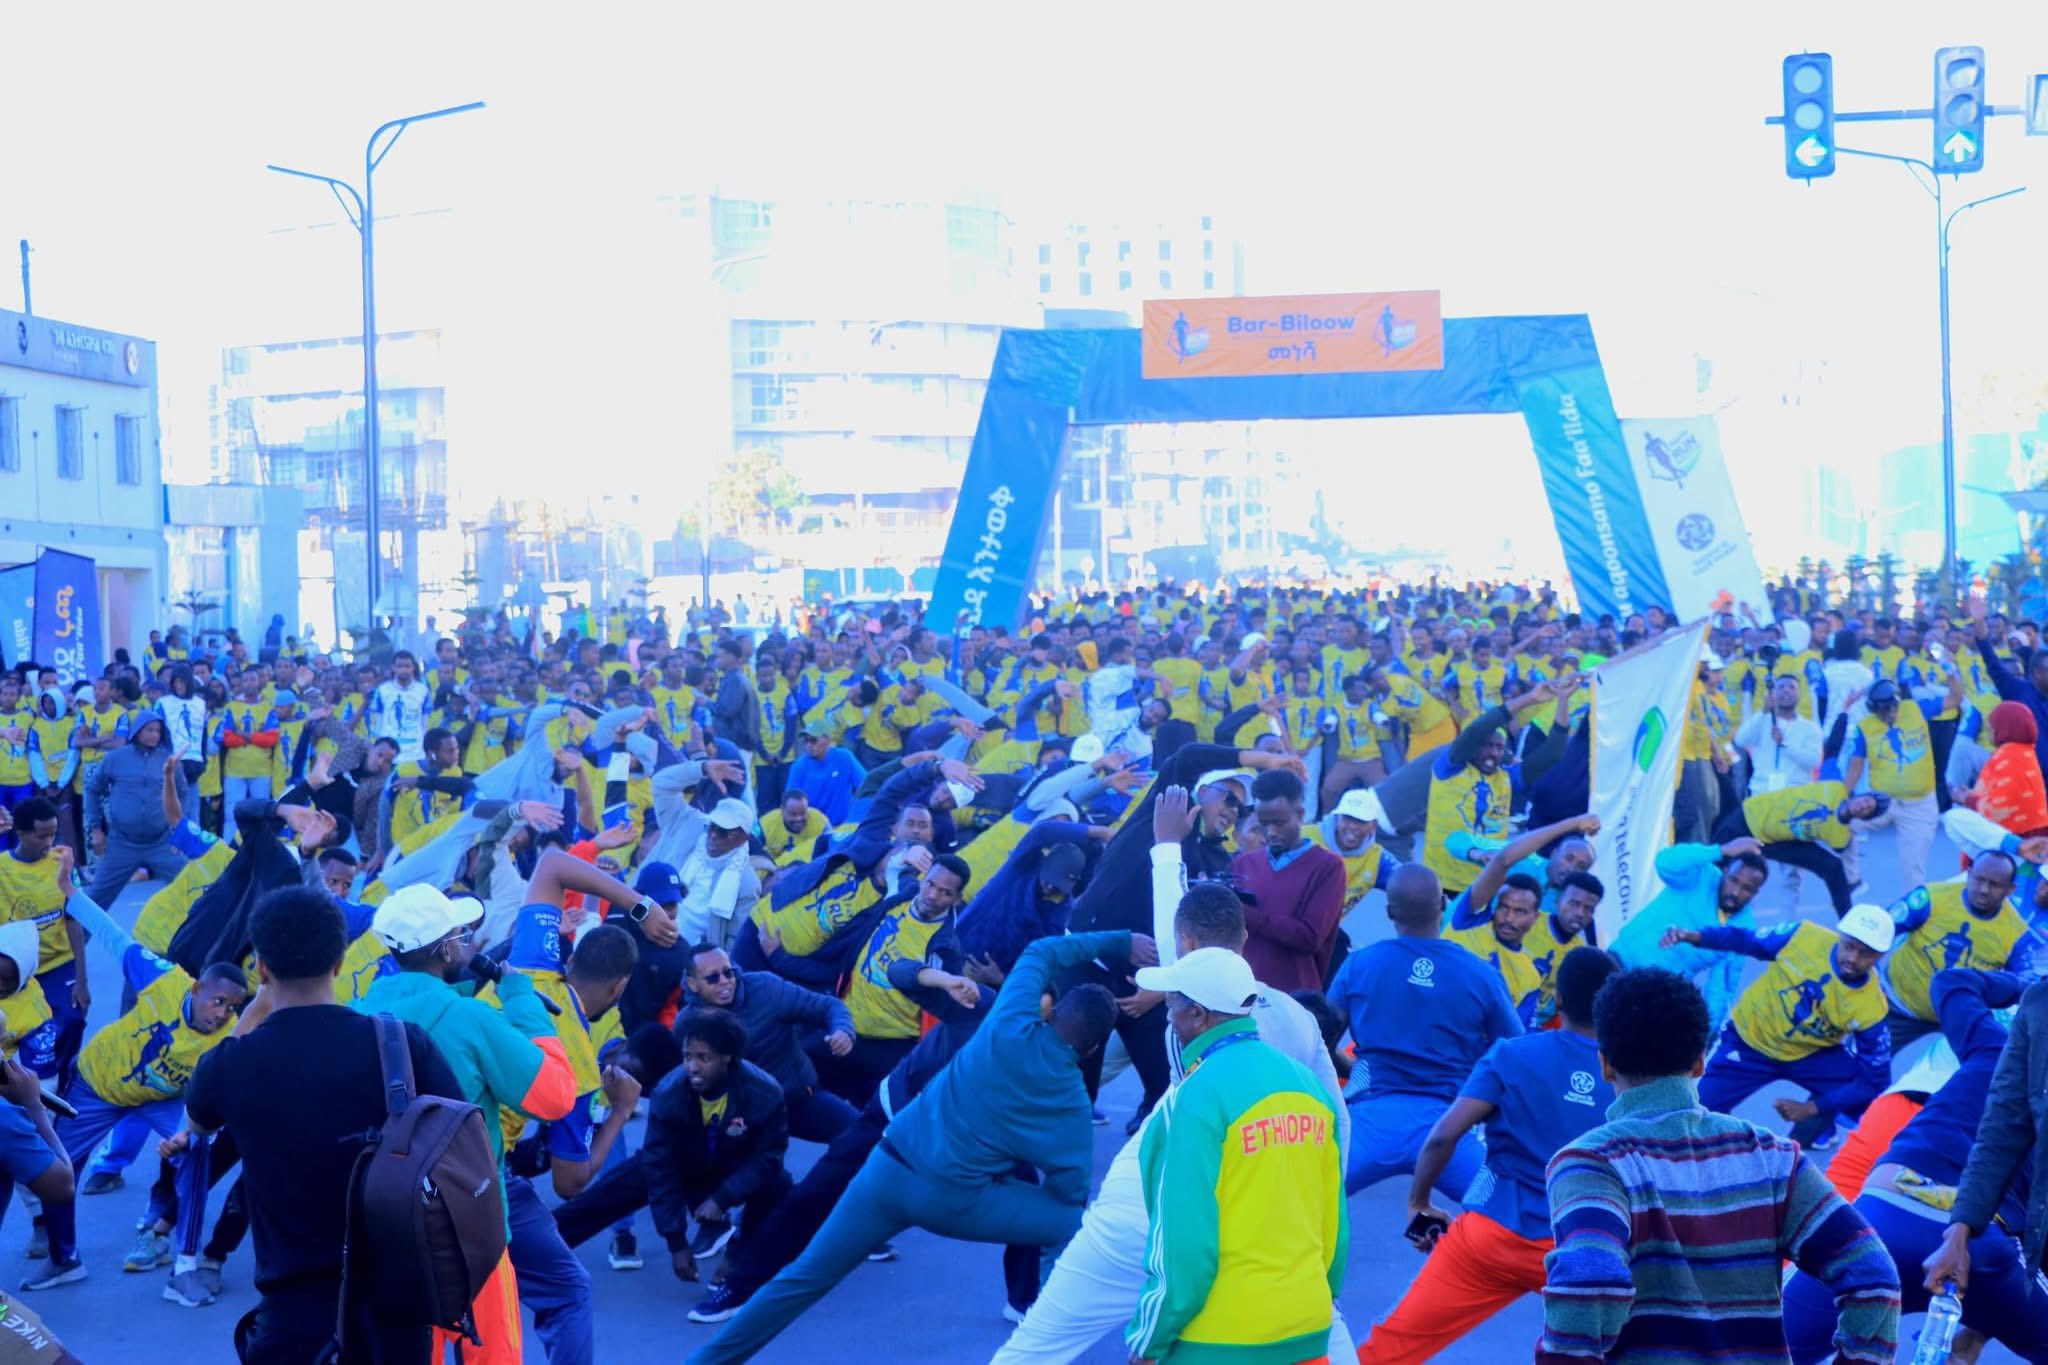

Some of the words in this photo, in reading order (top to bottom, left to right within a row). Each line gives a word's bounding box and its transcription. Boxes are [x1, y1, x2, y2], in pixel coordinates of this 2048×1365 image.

[1227, 314, 1356, 334] Bar-Biloow
[1268, 340, 1317, 362] መነሻ
[1585, 481, 1629, 600] aqoonsano
[829, 903, 850, 928] RU
[1242, 1113, 1325, 1155] ETHIOPIA
[1, 1313, 49, 1351] NIKE
